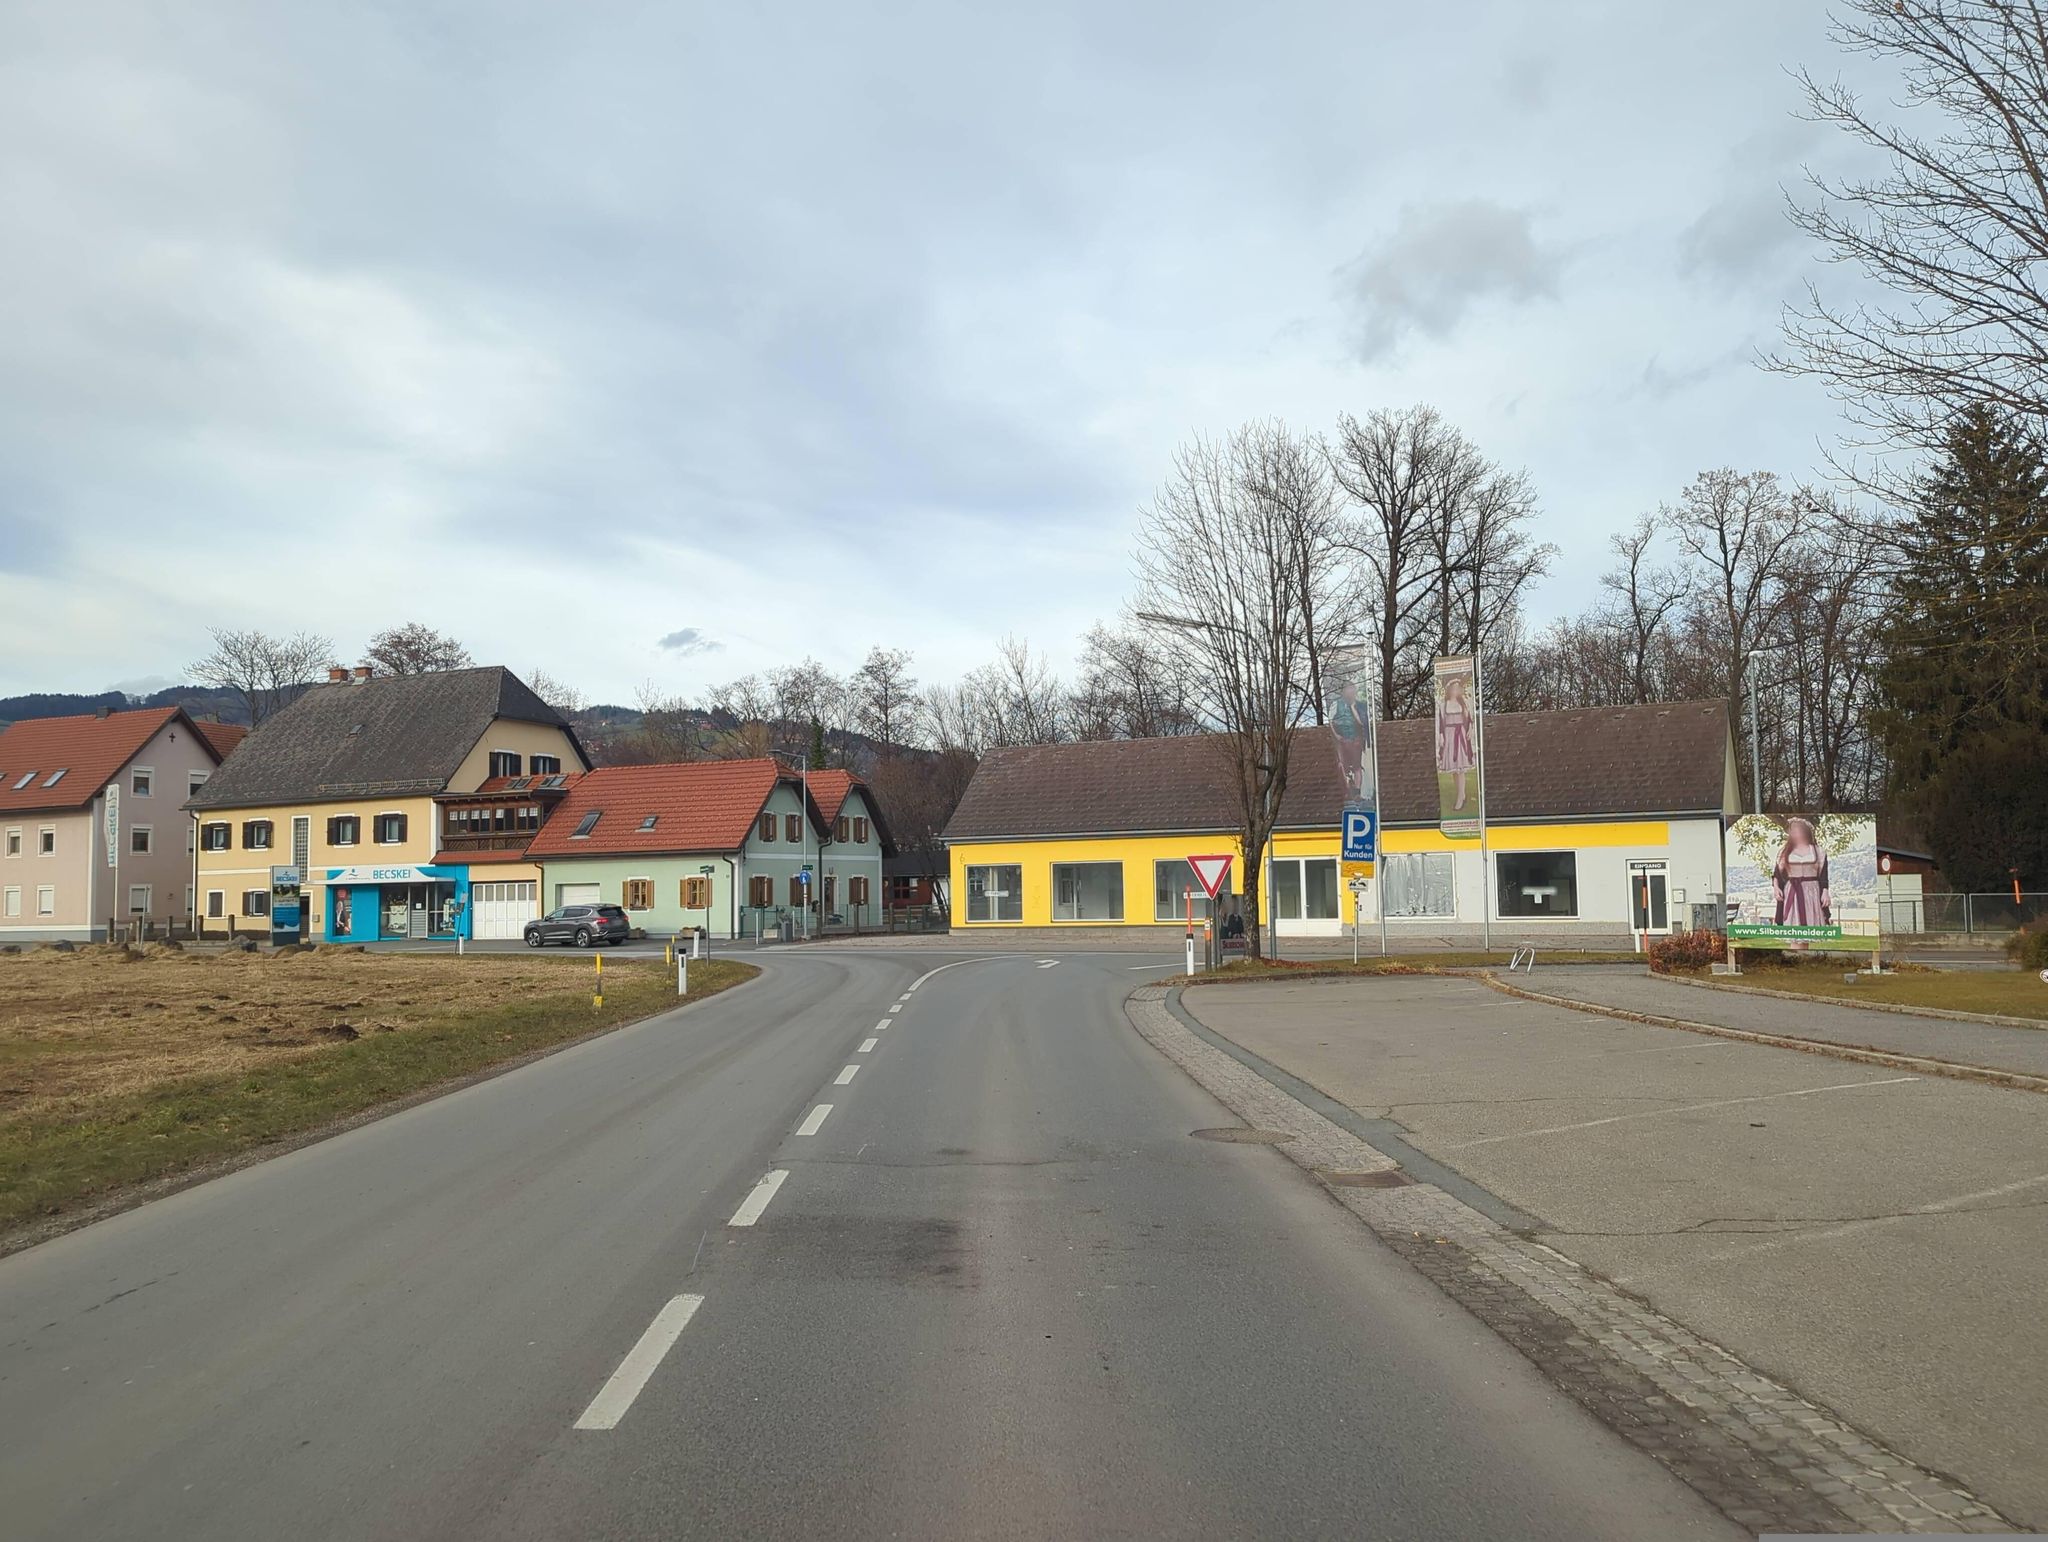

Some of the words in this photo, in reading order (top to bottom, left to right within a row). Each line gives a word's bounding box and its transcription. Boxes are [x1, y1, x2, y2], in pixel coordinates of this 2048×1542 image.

[1347, 814, 1371, 849] P
[1344, 850, 1373, 859] Kunden
[372, 869, 411, 880] BECSKEI
[1734, 927, 1837, 937] www.Silberschneider.at
